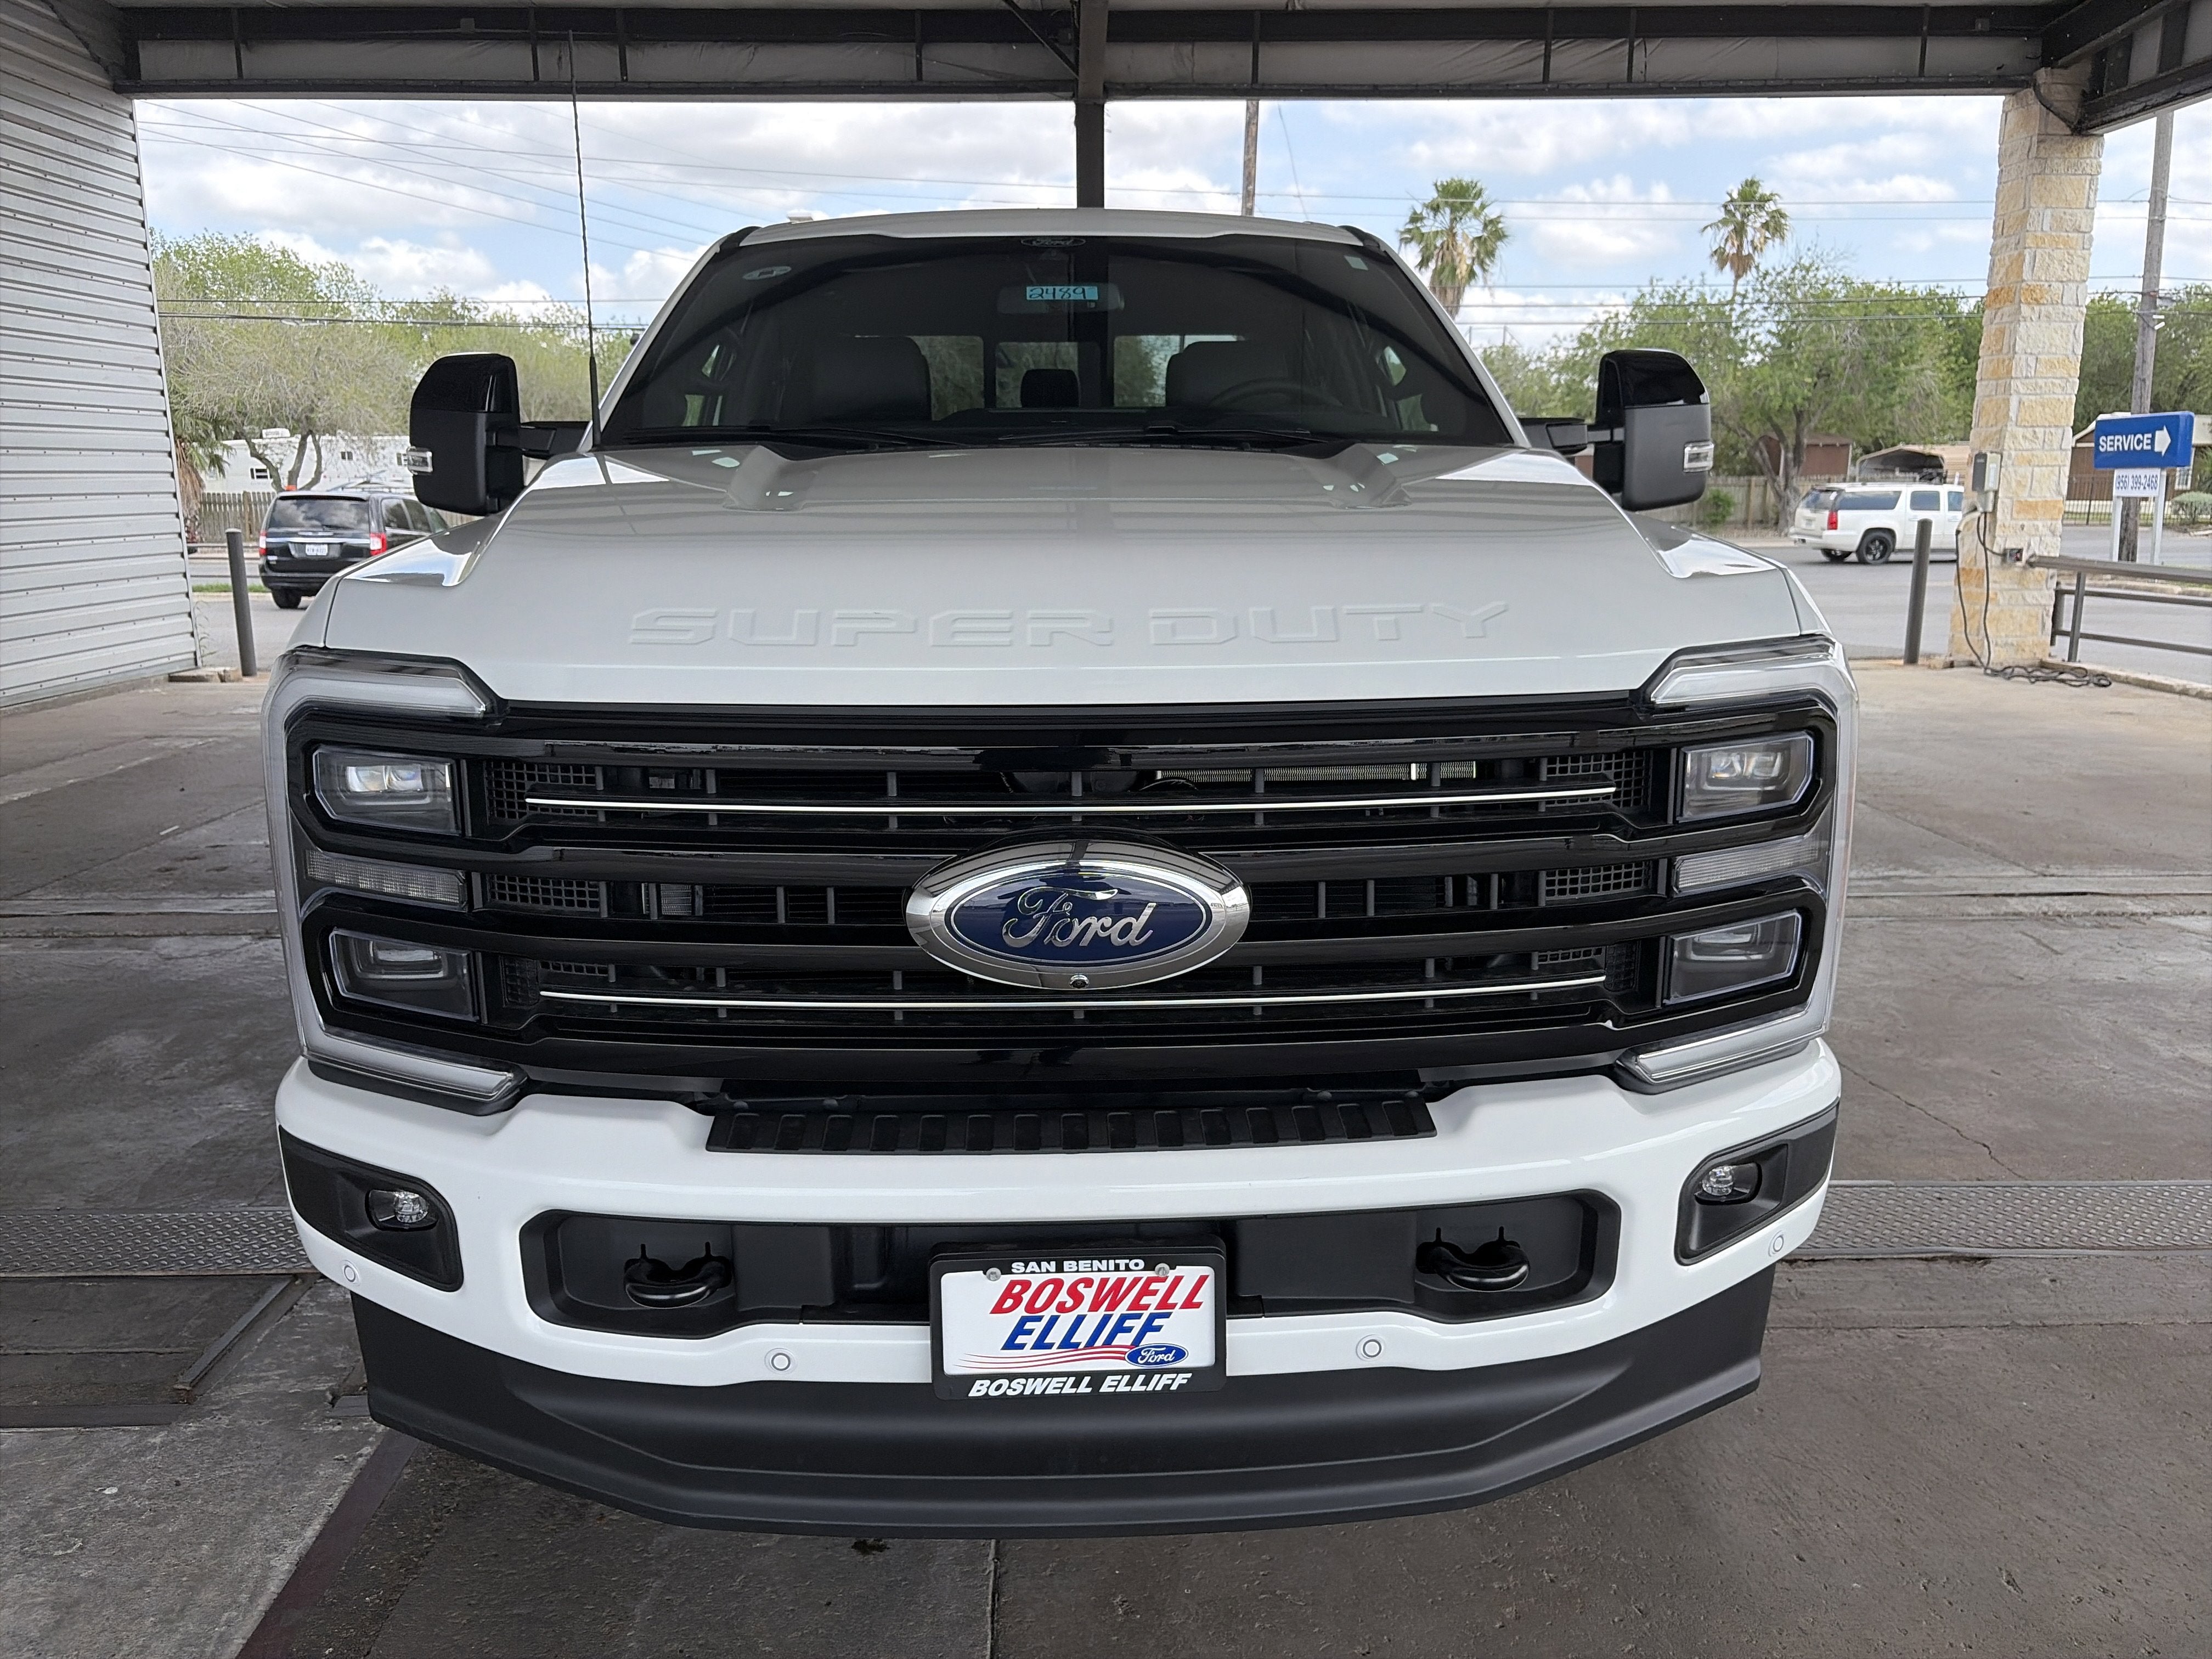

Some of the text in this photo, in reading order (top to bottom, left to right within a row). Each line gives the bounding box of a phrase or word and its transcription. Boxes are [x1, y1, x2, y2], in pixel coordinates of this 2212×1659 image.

[1029, 287, 1086, 300] 2489
[2099, 433, 2152, 452] SERVICE
[2115, 474, 2158, 491] (956) 399-2468
[628, 601, 1509, 647] SUPER DUTY
[1002, 886, 1158, 947] Ford
[1011, 1259, 1144, 1273] SAN BENITO
[989, 1274, 1210, 1314] BOSWELL
[1000, 1312, 1173, 1351] ELLIFF
[1137, 1346, 1176, 1363] Ford
[968, 1373, 1193, 1397] BOSWELL ELLIFF
